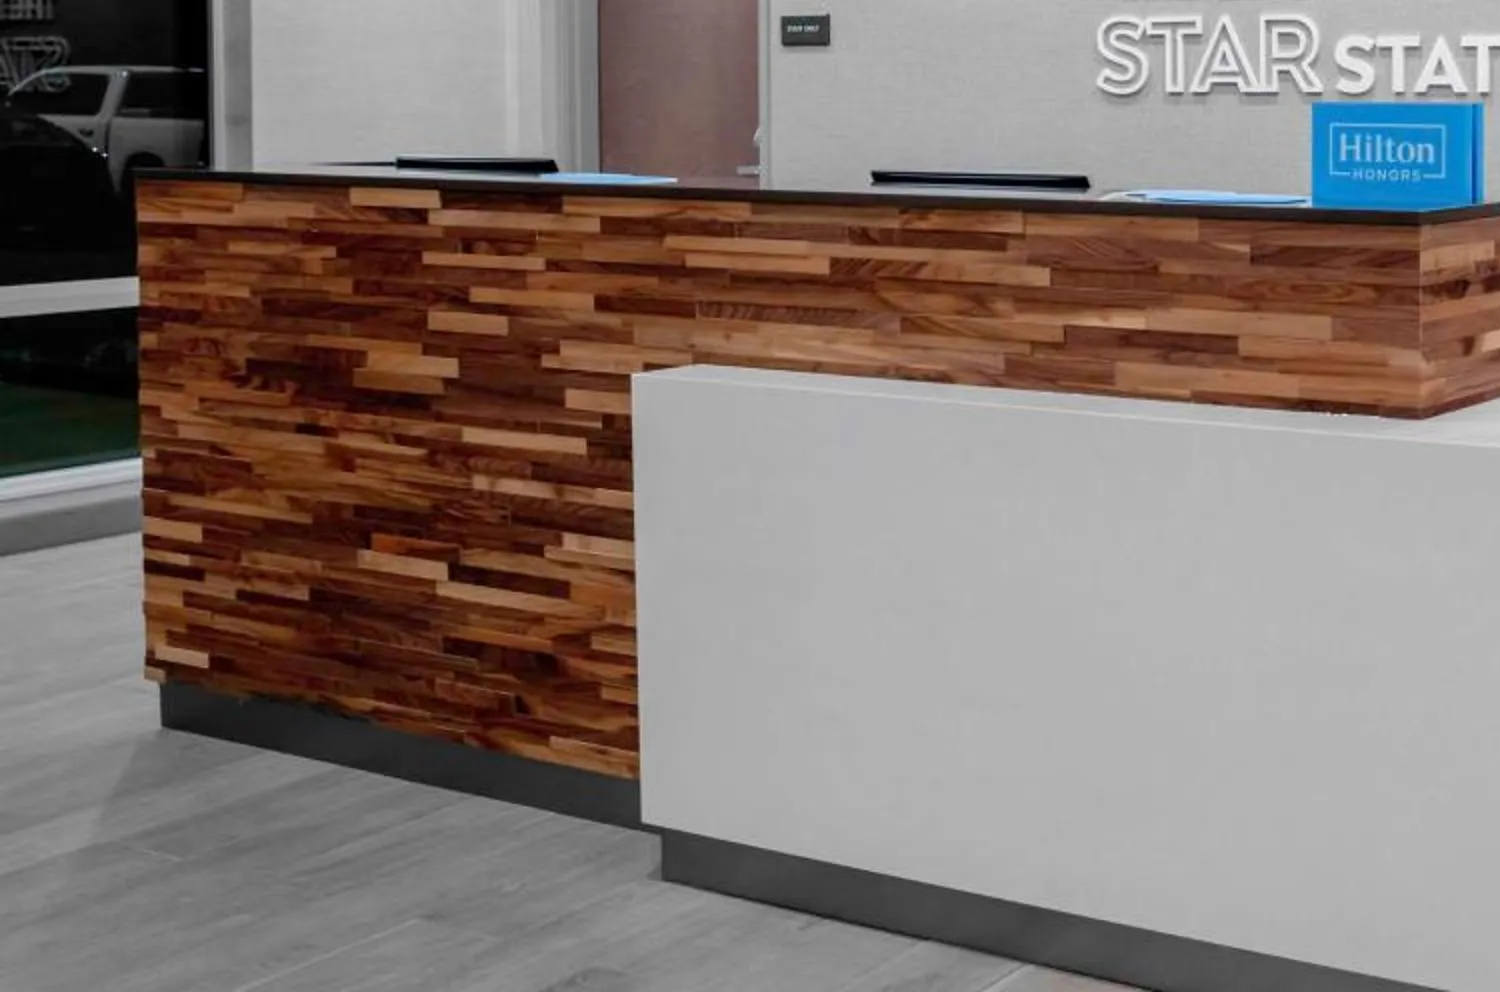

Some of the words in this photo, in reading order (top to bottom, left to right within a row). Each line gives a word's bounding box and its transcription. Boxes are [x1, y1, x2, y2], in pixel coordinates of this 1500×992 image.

[1097, 13, 1323, 95] STAR
[1339, 132, 1436, 165] Hilton
[1352, 168, 1422, 182] HONORS
